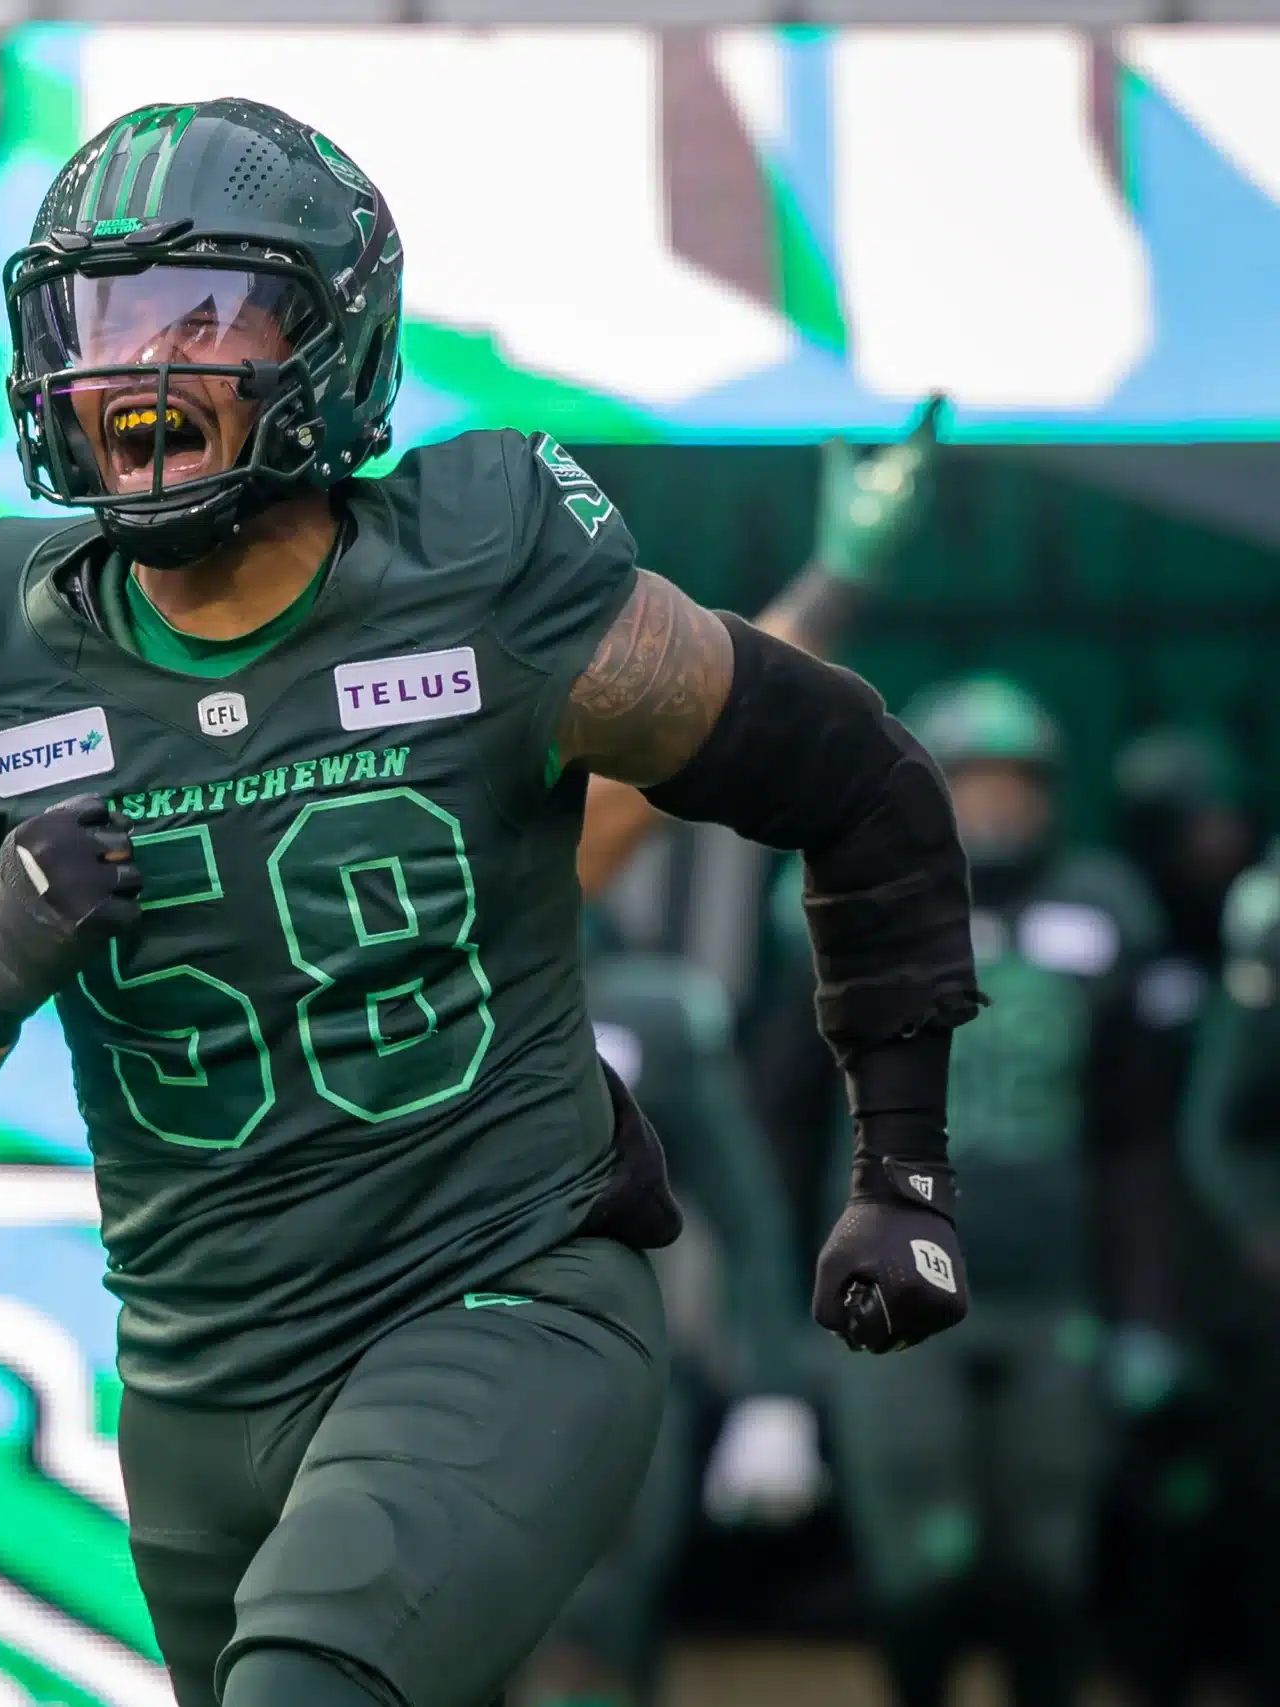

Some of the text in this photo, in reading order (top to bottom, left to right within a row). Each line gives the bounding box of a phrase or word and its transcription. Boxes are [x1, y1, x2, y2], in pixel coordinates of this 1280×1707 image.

[92, 223, 144, 237] NATION
[97, 217, 140, 228] RIDER
[343, 670, 472, 709] TELUS
[206, 704, 241, 726] CFL
[106, 747, 410, 821] SKATCHEWAN
[78, 785, 496, 1150] 58
[919, 1248, 949, 1280] CFL
